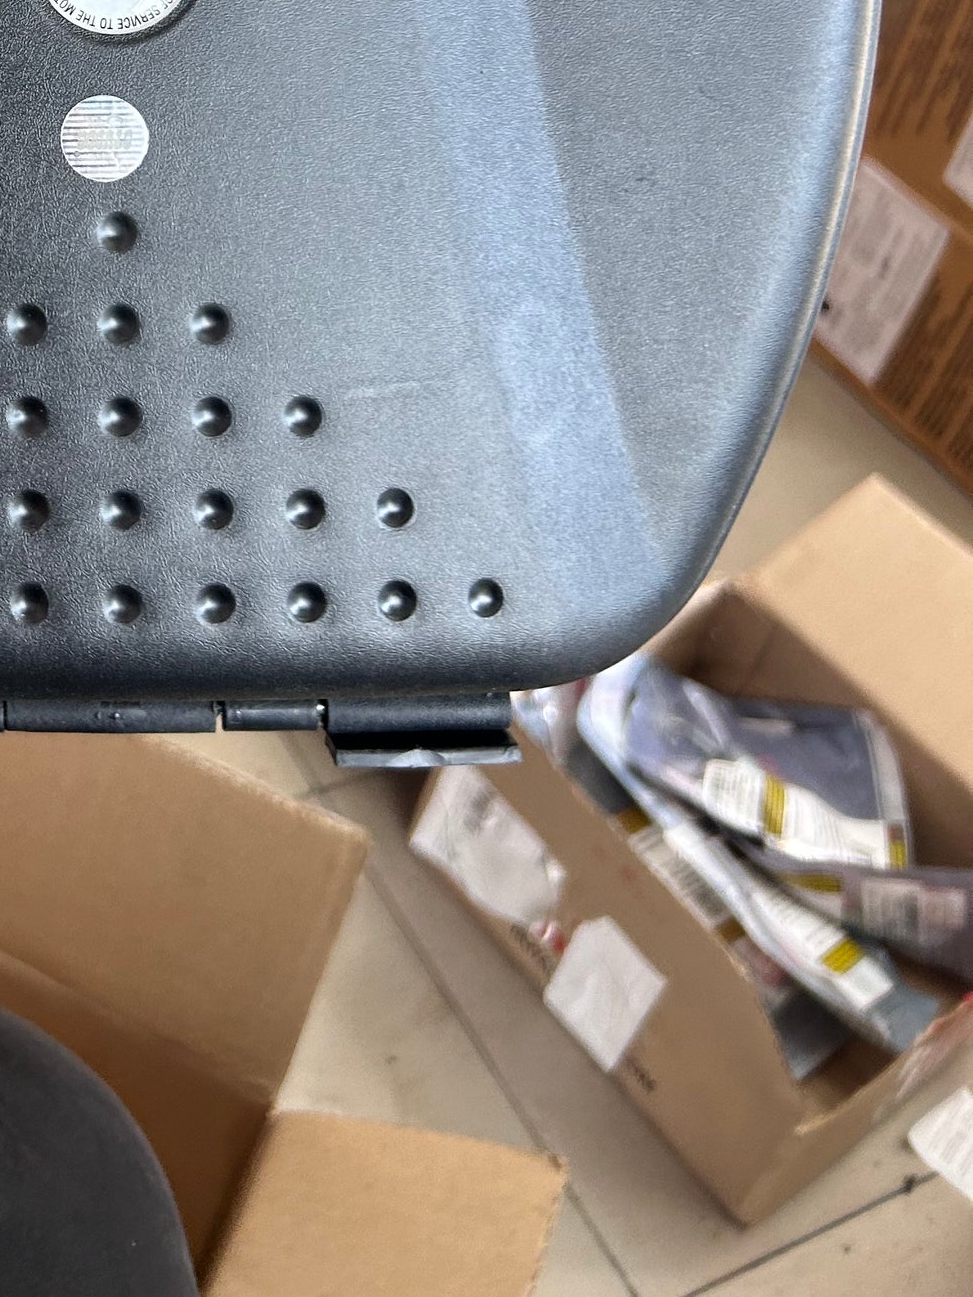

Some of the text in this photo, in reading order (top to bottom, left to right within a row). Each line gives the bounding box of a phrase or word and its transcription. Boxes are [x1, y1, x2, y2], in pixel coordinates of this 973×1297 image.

[75, 10, 96, 27] THE
[99, 17, 113, 30] TO
[117, 4, 160, 30] SERVICE
